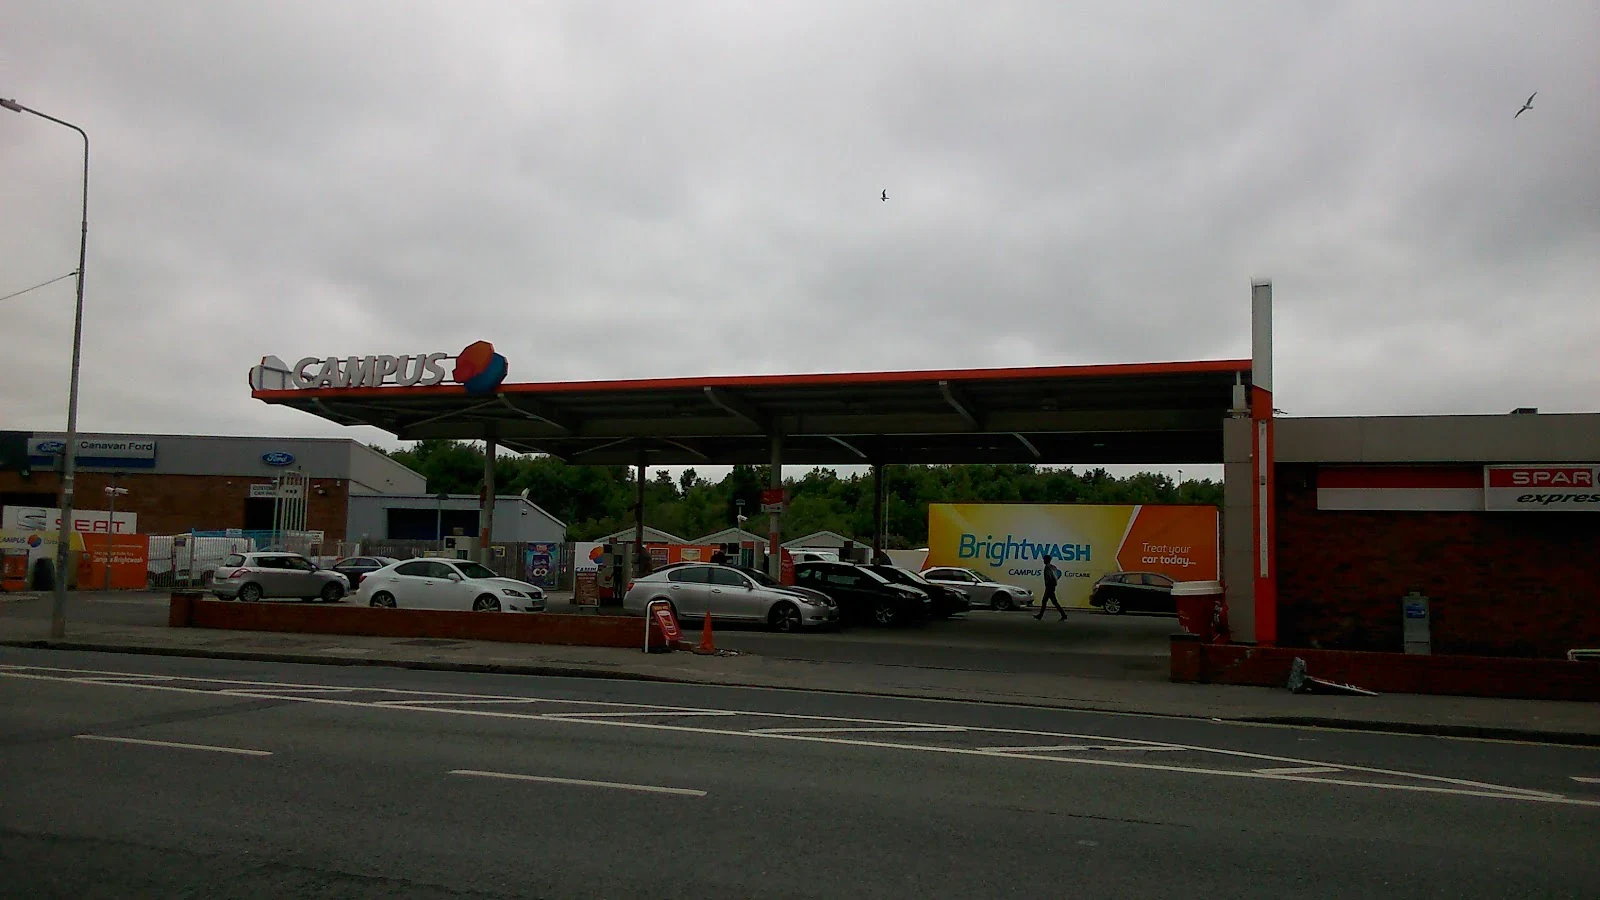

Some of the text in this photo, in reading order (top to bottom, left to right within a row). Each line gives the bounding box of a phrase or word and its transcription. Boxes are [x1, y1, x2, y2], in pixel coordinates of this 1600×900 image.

[292, 352, 448, 389] CAMPUS
[80, 441, 154, 451] Canavan Ford
[1512, 471, 1592, 485] SPAR
[1141, 542, 1192, 555] Treat your
[1141, 556, 1159, 564] car
[1008, 568, 1042, 577] CAMPUS
